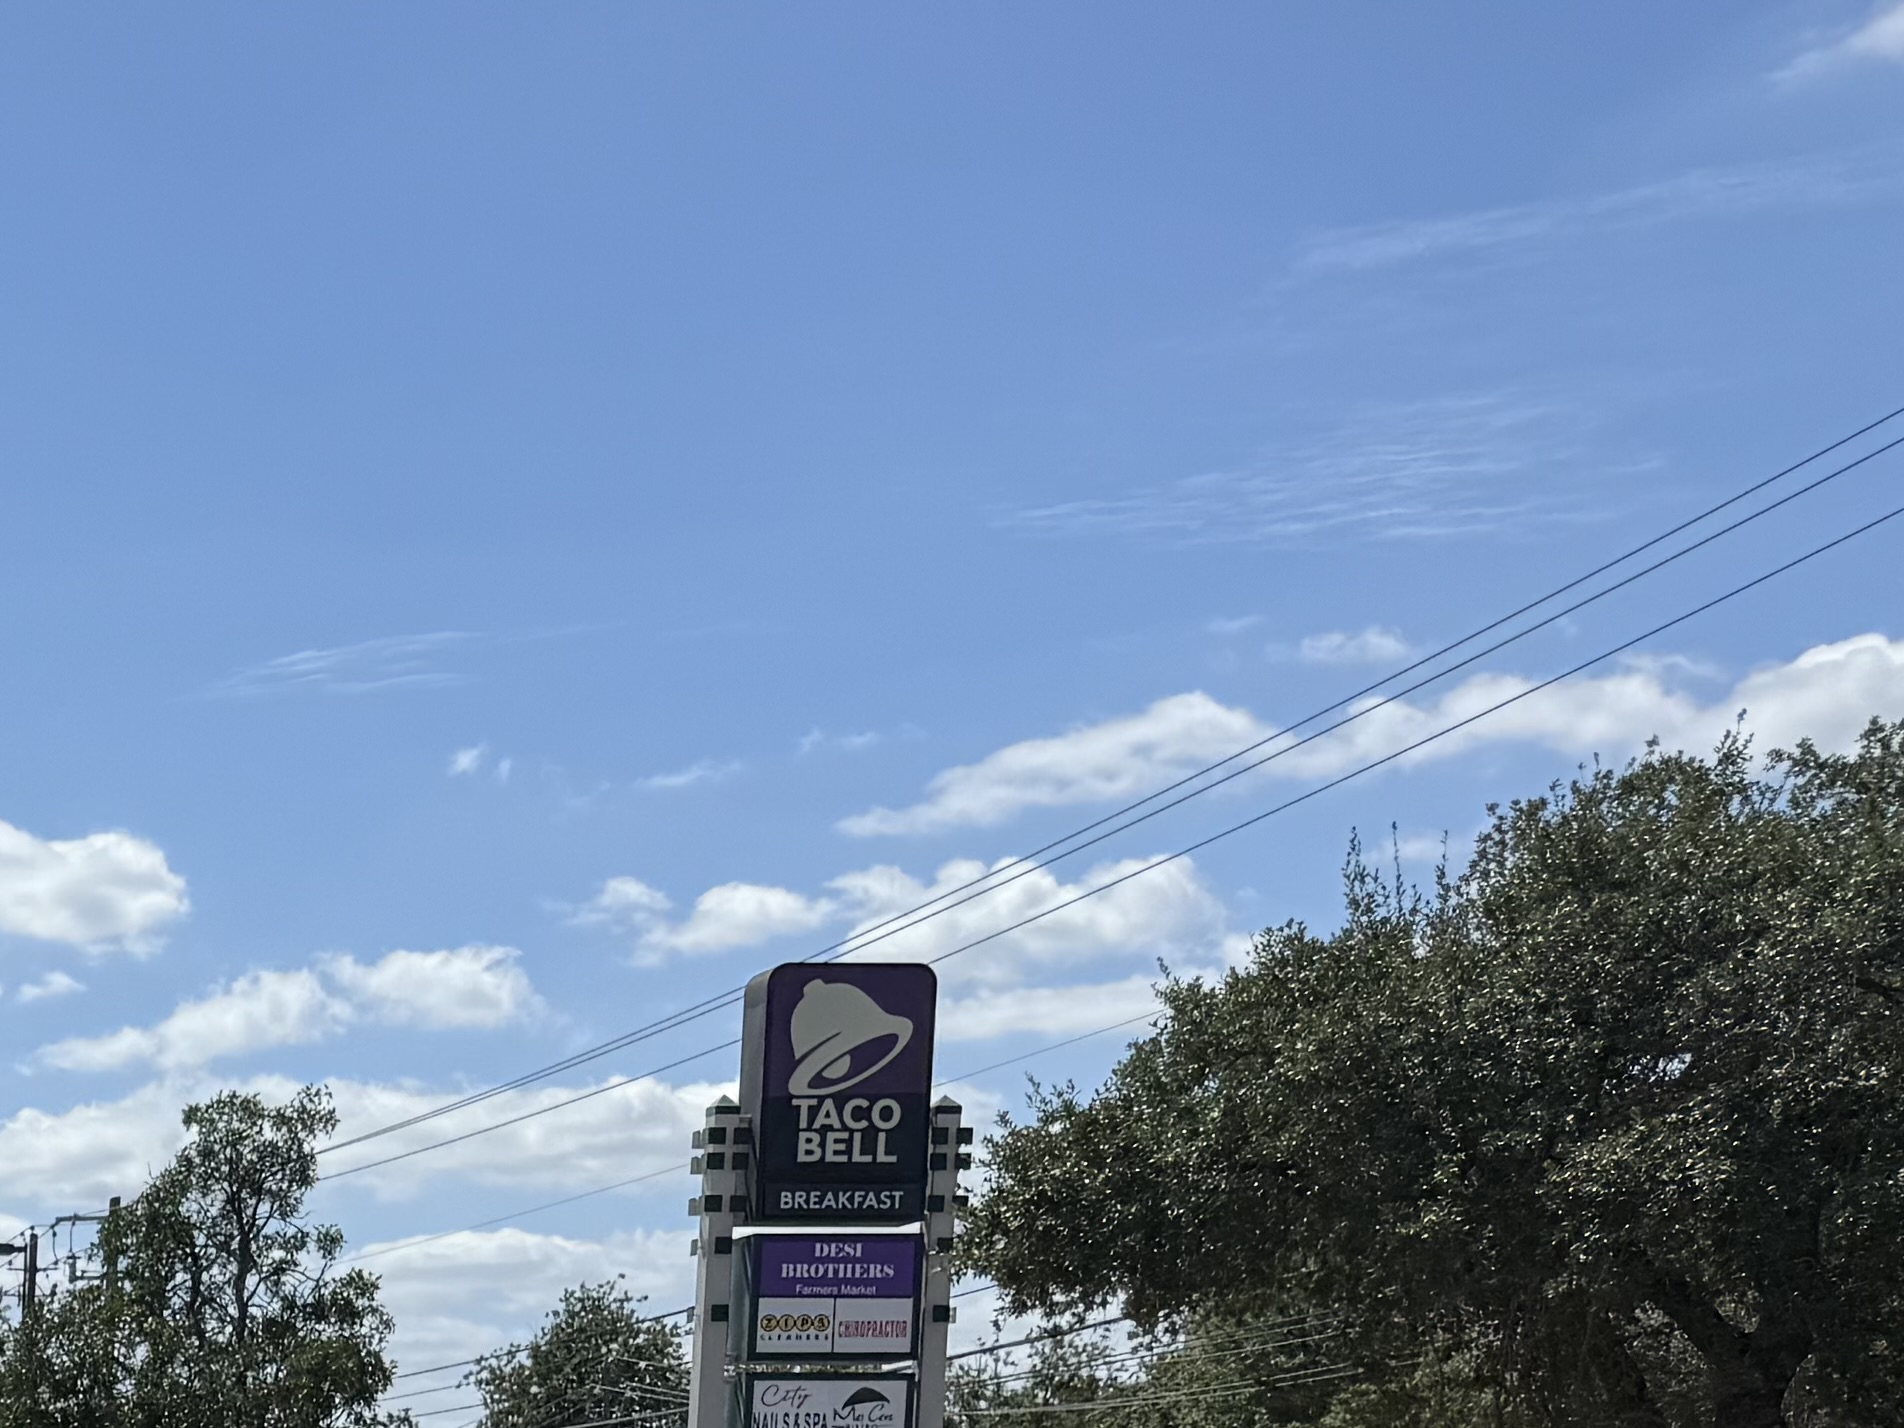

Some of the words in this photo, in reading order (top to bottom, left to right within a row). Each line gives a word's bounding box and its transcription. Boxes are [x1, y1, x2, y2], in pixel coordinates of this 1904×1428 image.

[791, 1097, 902, 1130] TACO
[796, 1131, 898, 1163] BELL
[780, 1191, 904, 1210] BREAKFAST
[814, 1242, 863, 1258] DESI
[780, 1263, 895, 1279] BROTHERS
[795, 1284, 838, 1296] Farmers
[841, 1284, 876, 1296] Market
[760, 1384, 813, 1409] City
